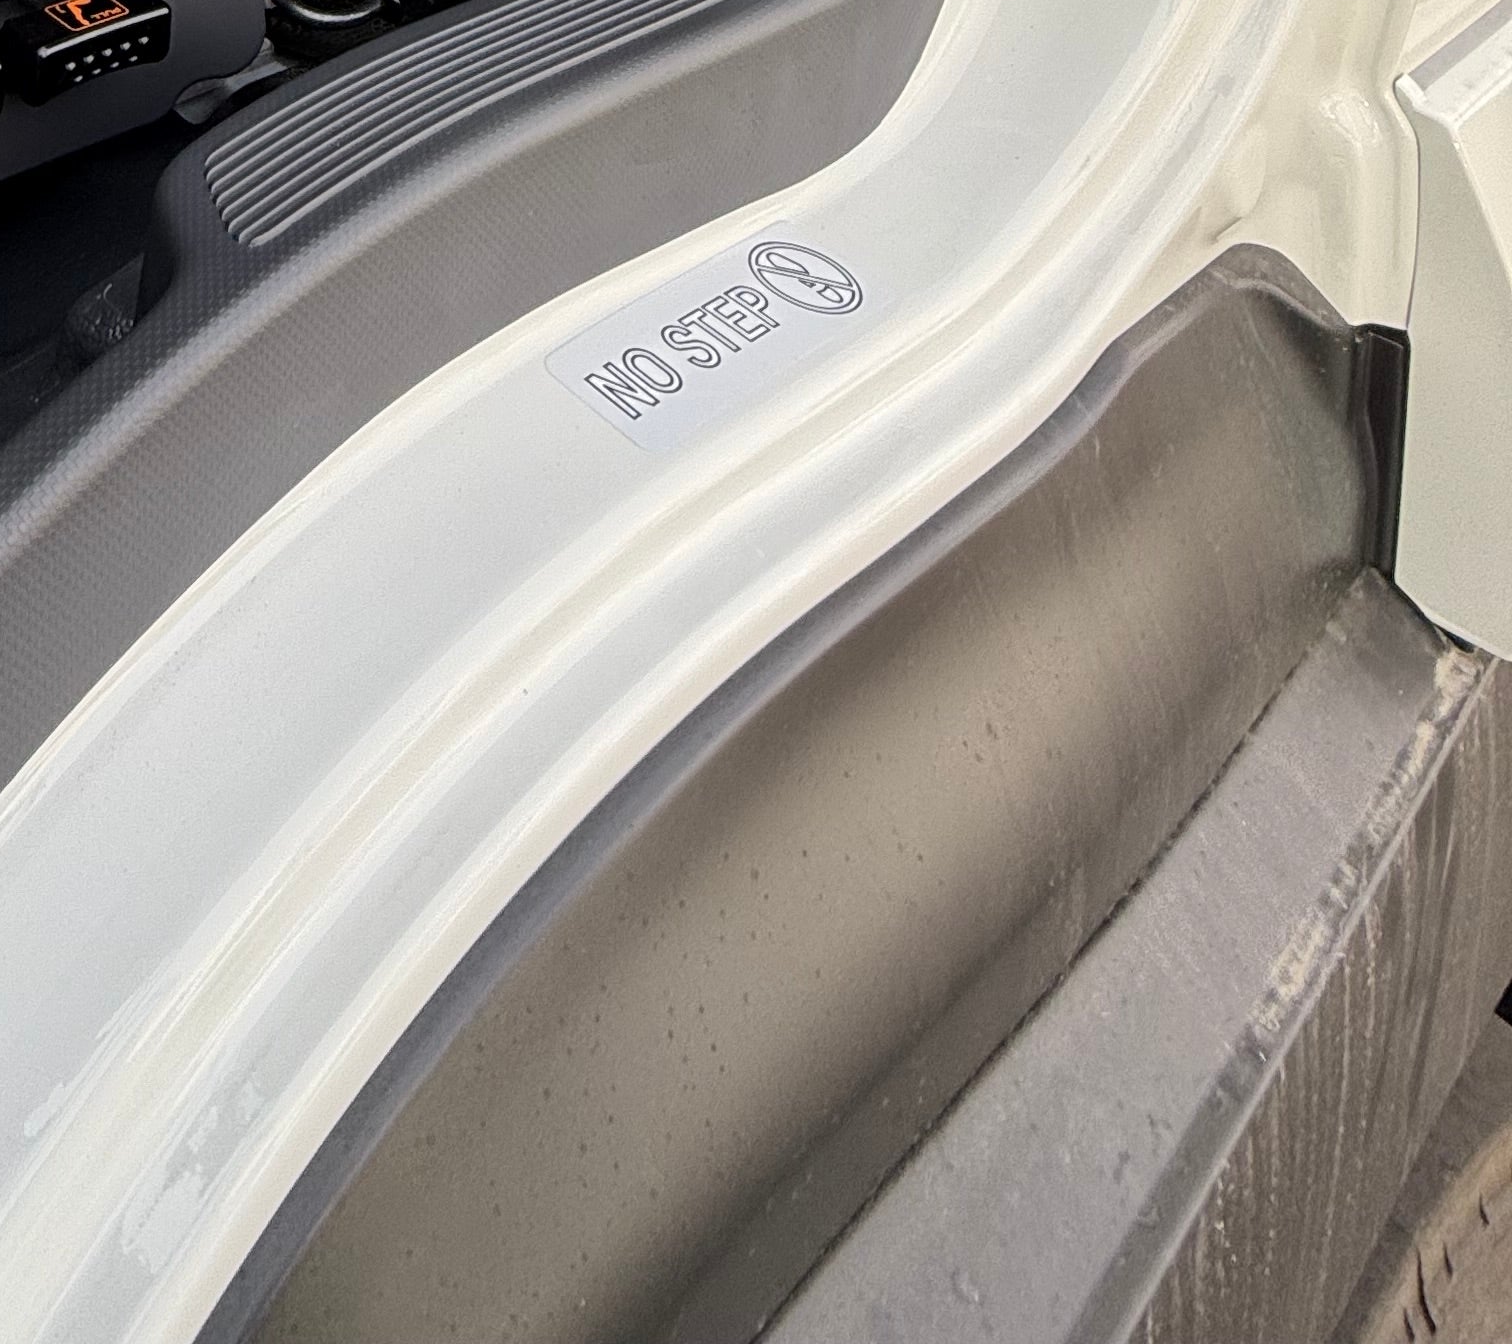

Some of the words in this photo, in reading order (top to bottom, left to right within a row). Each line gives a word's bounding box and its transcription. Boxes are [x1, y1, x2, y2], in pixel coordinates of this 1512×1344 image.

[90, 6, 123, 20] PULL
[583, 347, 683, 420] NO
[661, 284, 781, 369] STEP
